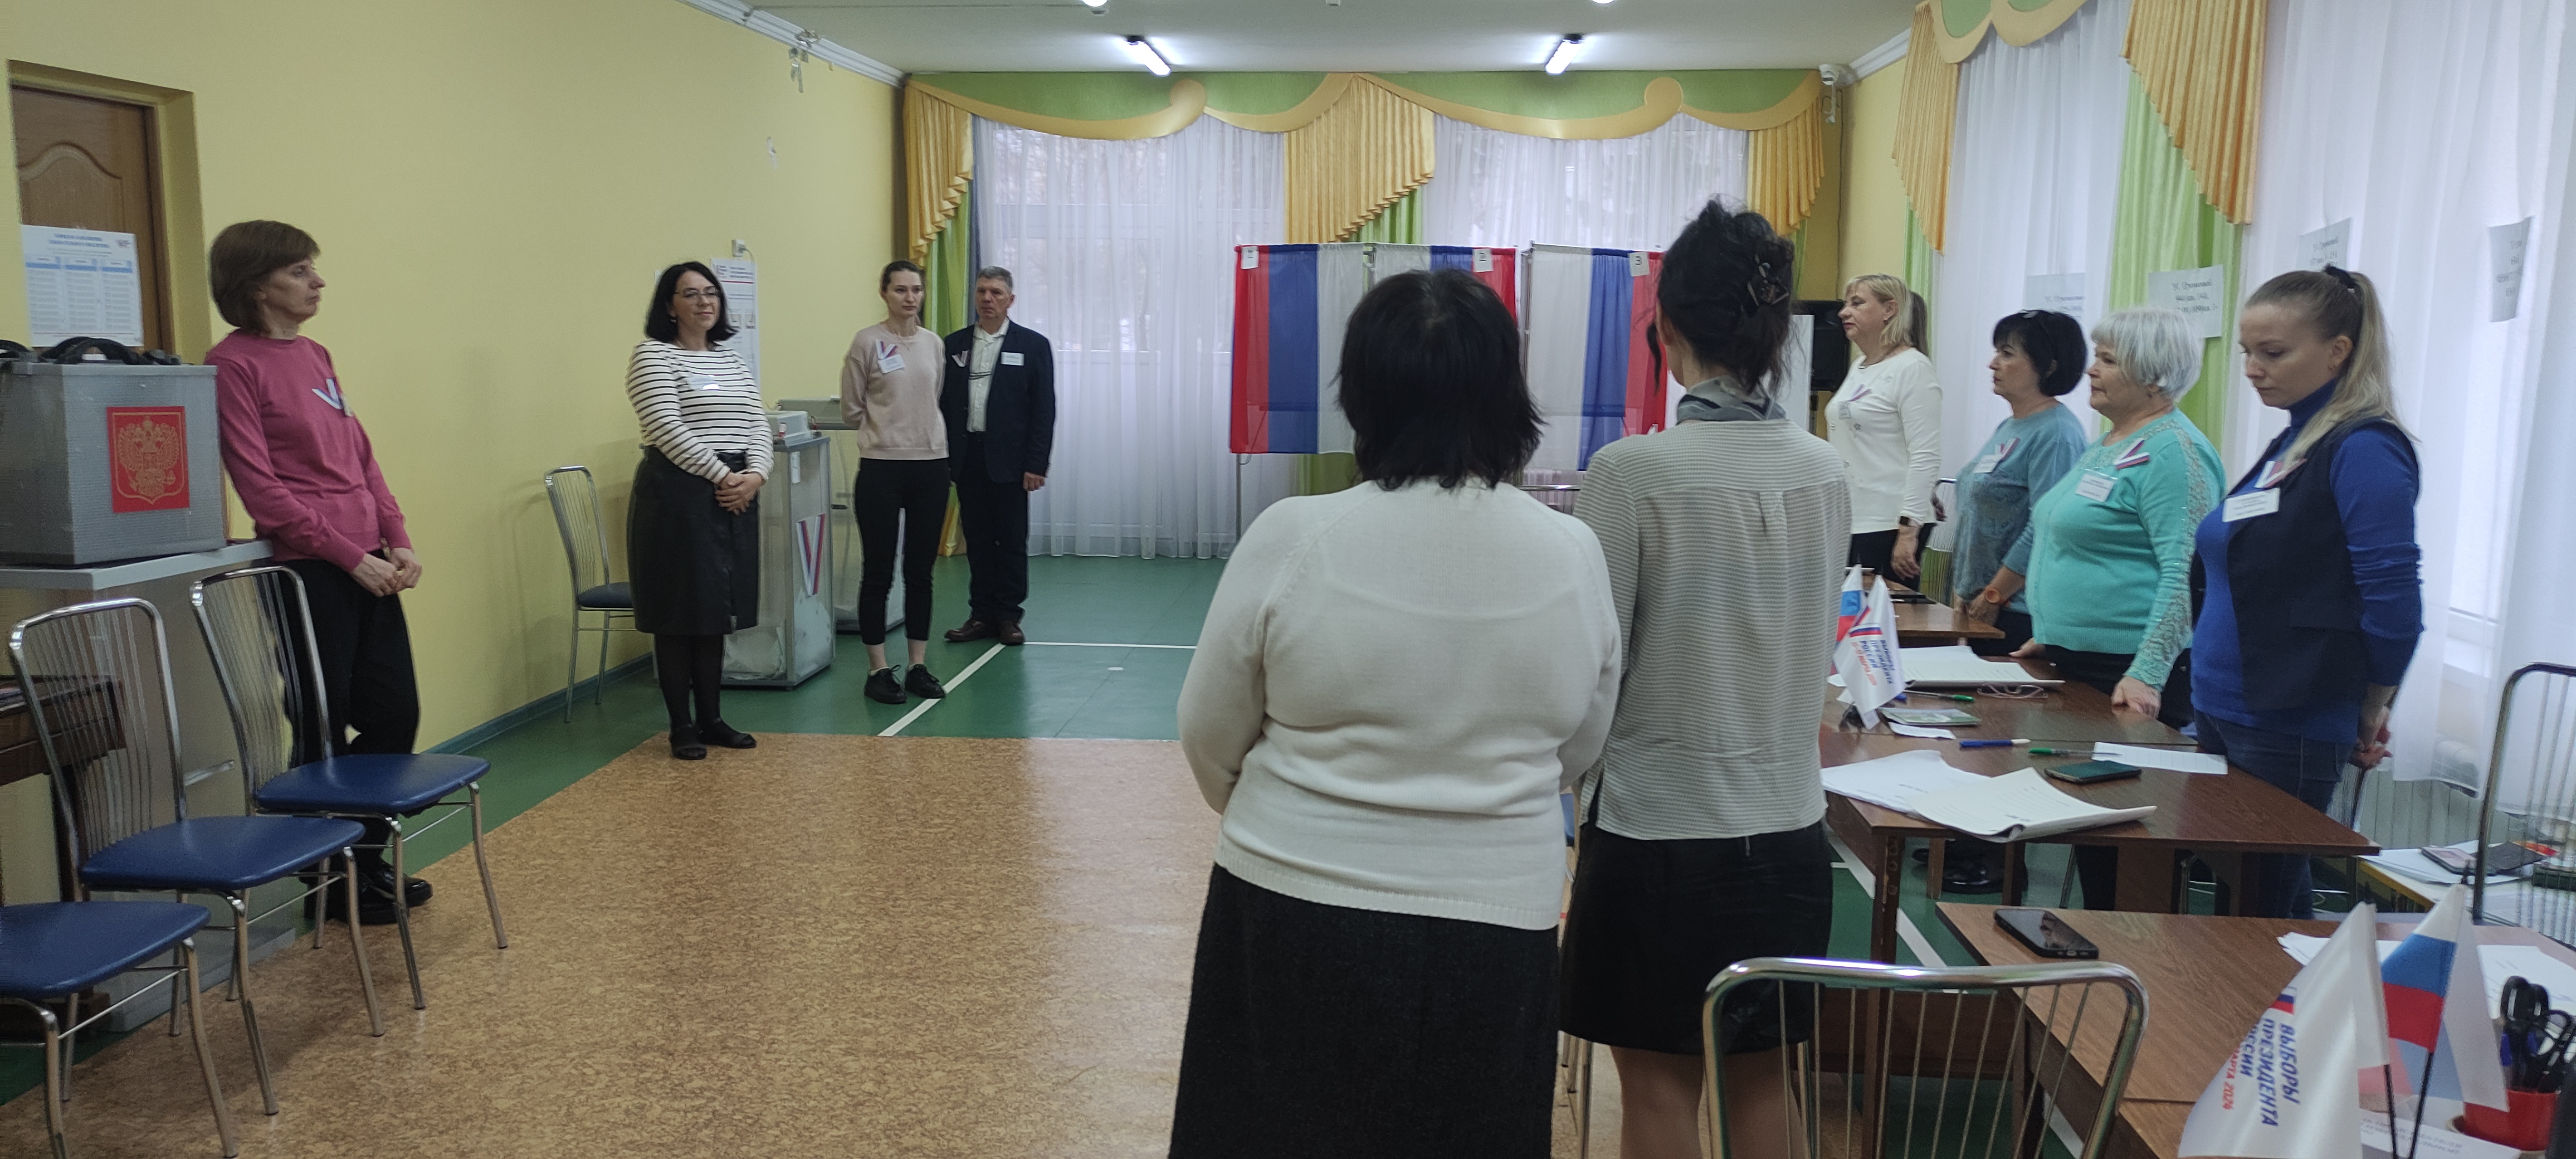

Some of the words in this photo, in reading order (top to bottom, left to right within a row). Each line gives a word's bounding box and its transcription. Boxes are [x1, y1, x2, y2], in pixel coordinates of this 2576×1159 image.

[1479, 252, 1487, 261] 2
[1635, 256, 1643, 265] 3
[2240, 1022, 2258, 1078] ОССИИ
[2279, 1023, 2301, 1105] ВЫБОРЫ
[2256, 1018, 2279, 1127] ПРЕЗИДЕНТА
[2222, 1082, 2235, 1111] 2024
